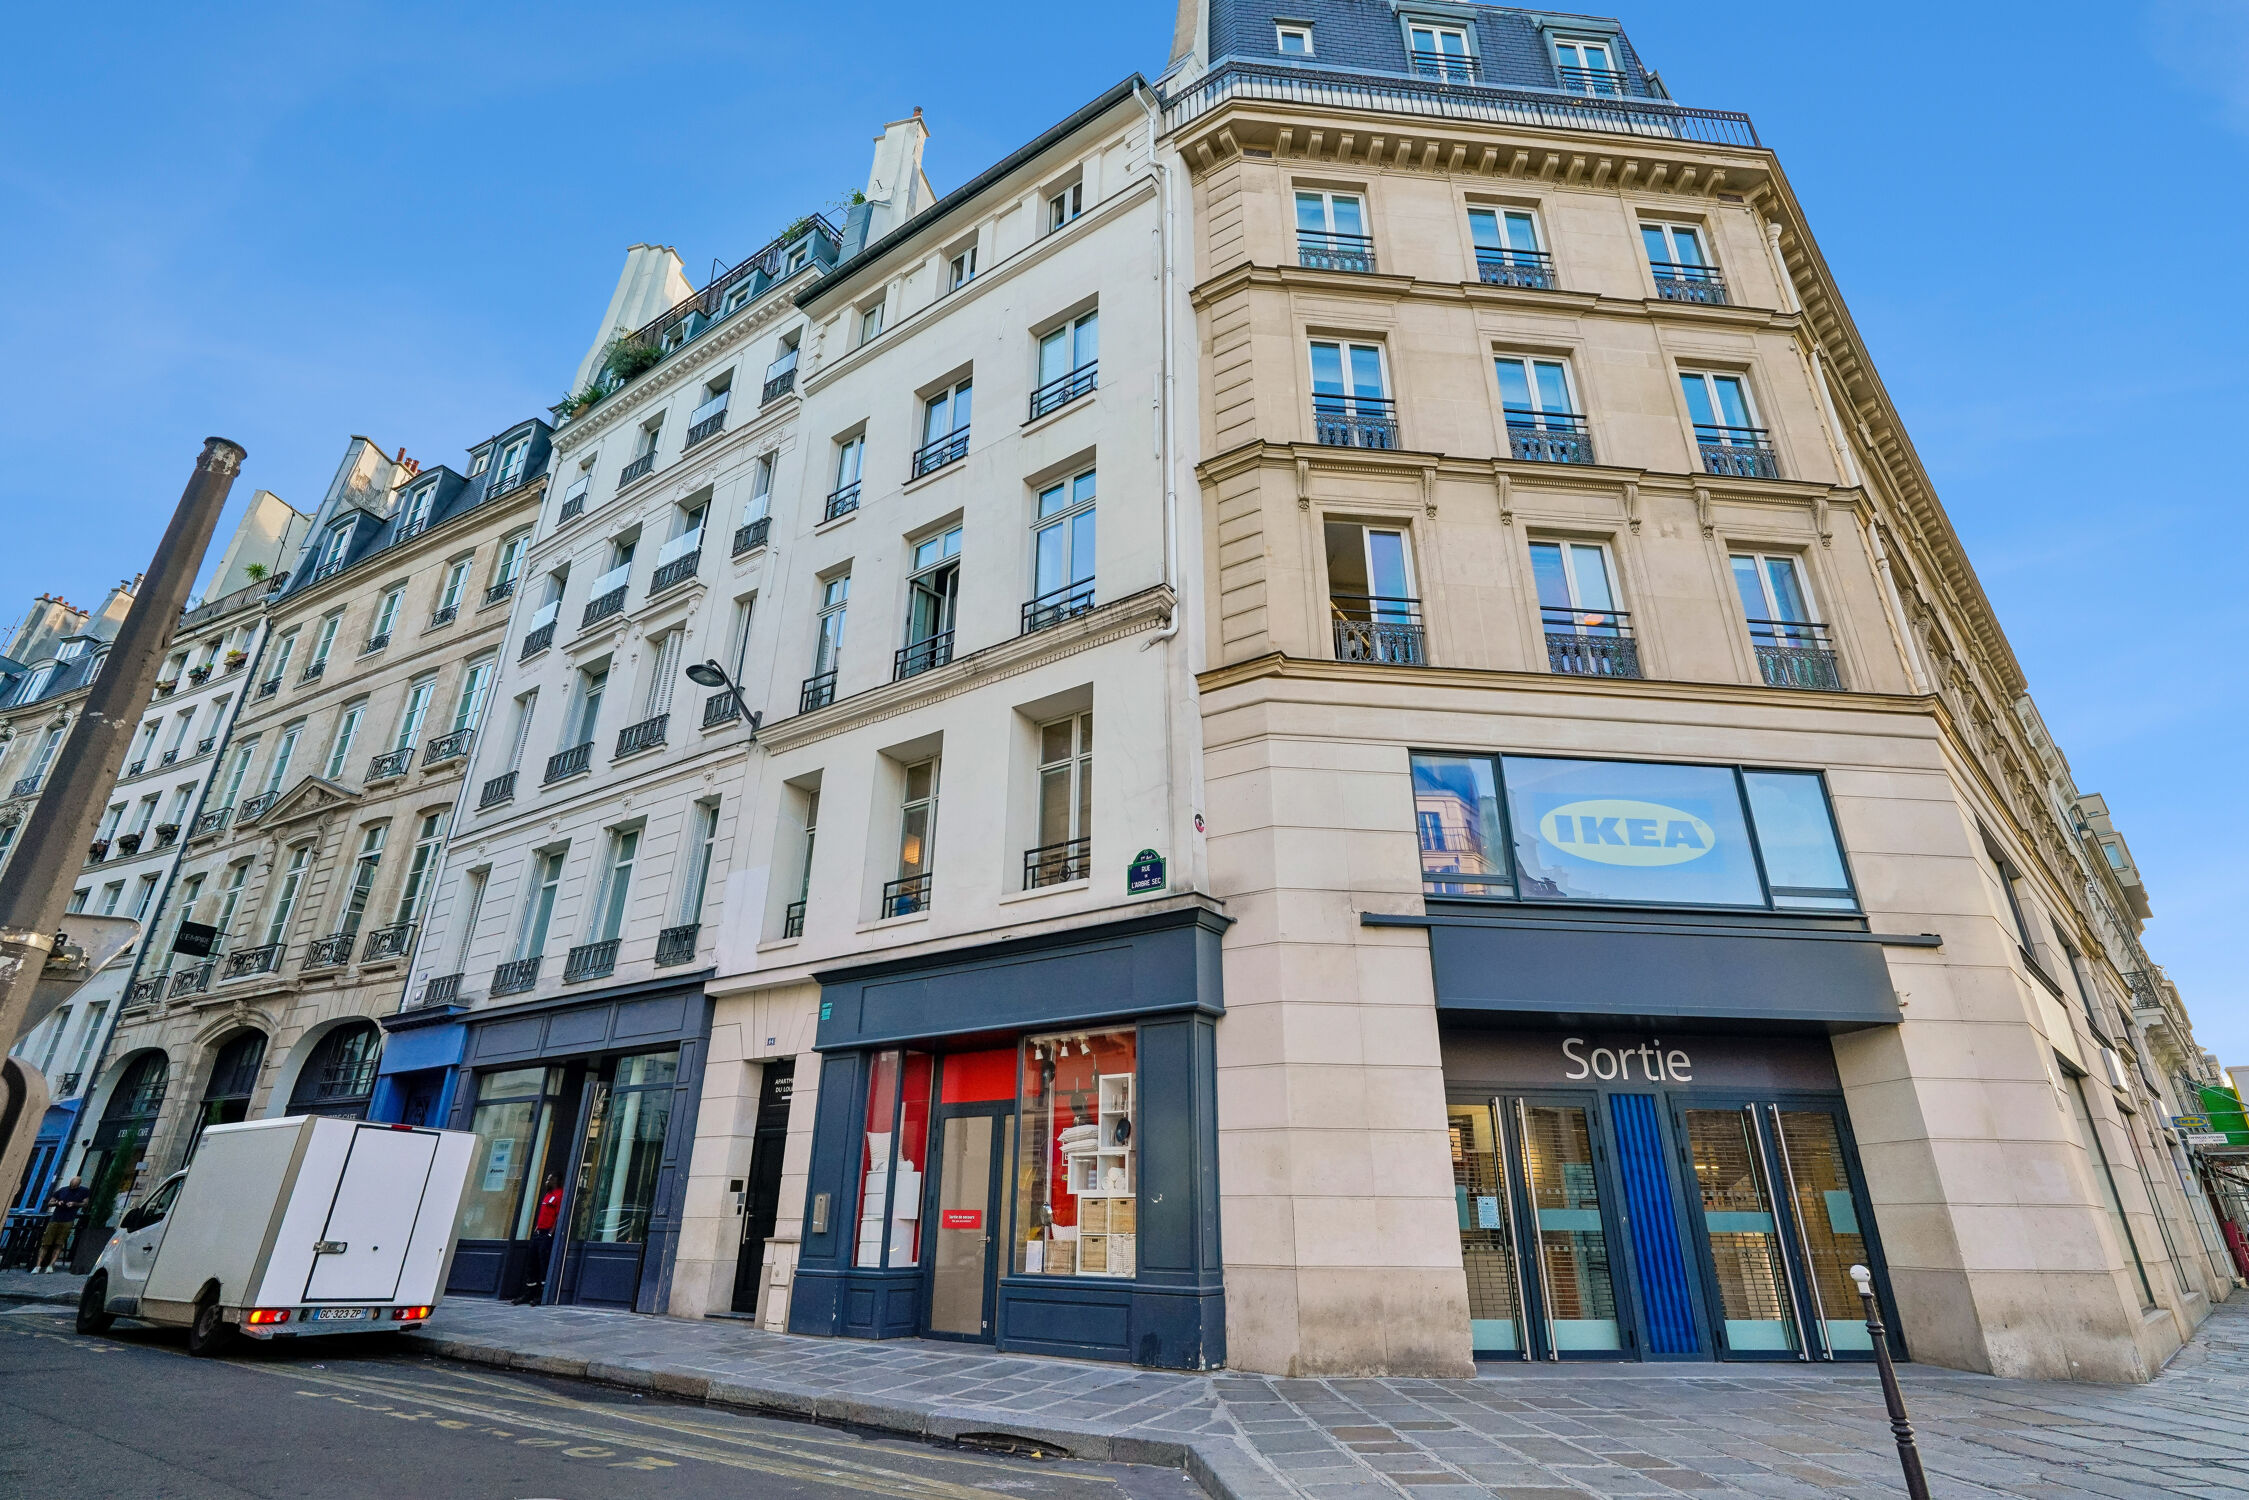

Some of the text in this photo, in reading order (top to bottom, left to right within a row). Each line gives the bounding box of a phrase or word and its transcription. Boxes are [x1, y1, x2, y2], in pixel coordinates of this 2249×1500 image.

[1554, 814, 1707, 850] IKEA
[1141, 864, 1151, 873] RUE
[1131, 877, 1162, 889] L'ARBRE SEC
[1562, 1037, 1693, 1082] Sortie
